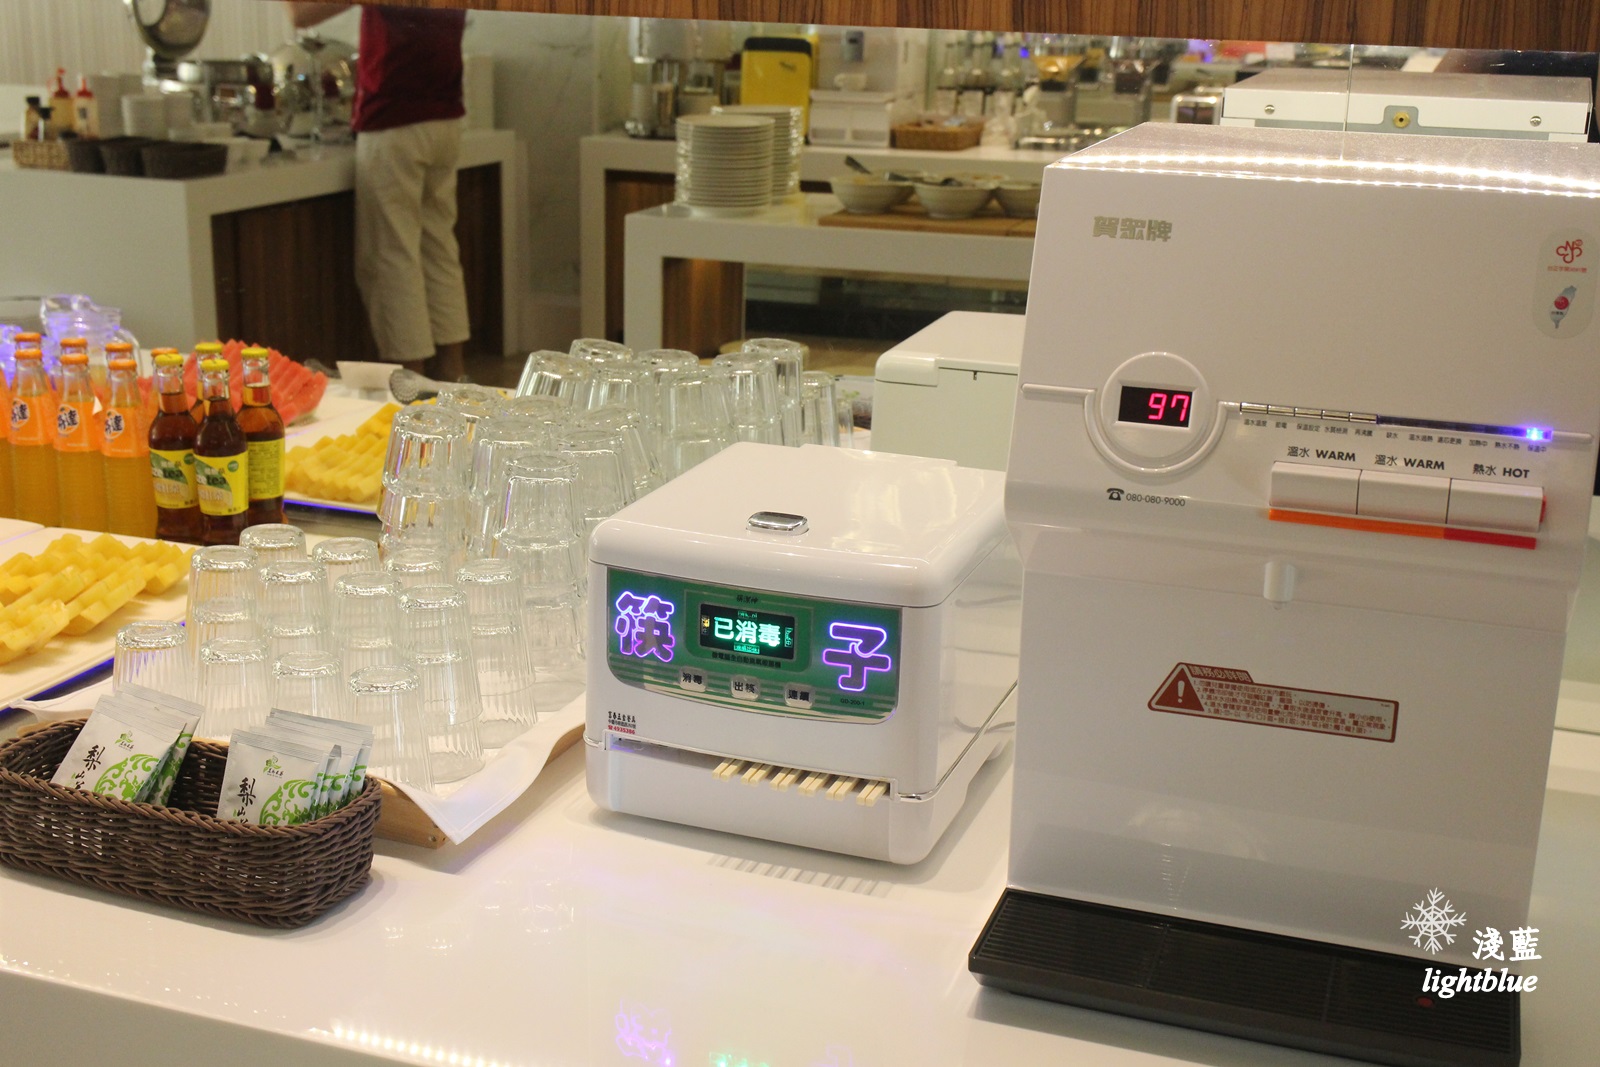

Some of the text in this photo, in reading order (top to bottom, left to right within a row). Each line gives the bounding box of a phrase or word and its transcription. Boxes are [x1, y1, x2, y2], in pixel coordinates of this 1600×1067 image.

[1148, 392, 1190, 422] 97
[1287, 446, 1356, 462] 溫水 WARM
[1374, 454, 1445, 471] 溫水 WARM
[1472, 463, 1530, 479] 熱水 HOT
[1126, 492, 1186, 507] 080-080-9000
[714, 616, 781, 648] 已消毒
[615, 591, 892, 692] 筷 子
[682, 672, 703, 686] 消毒
